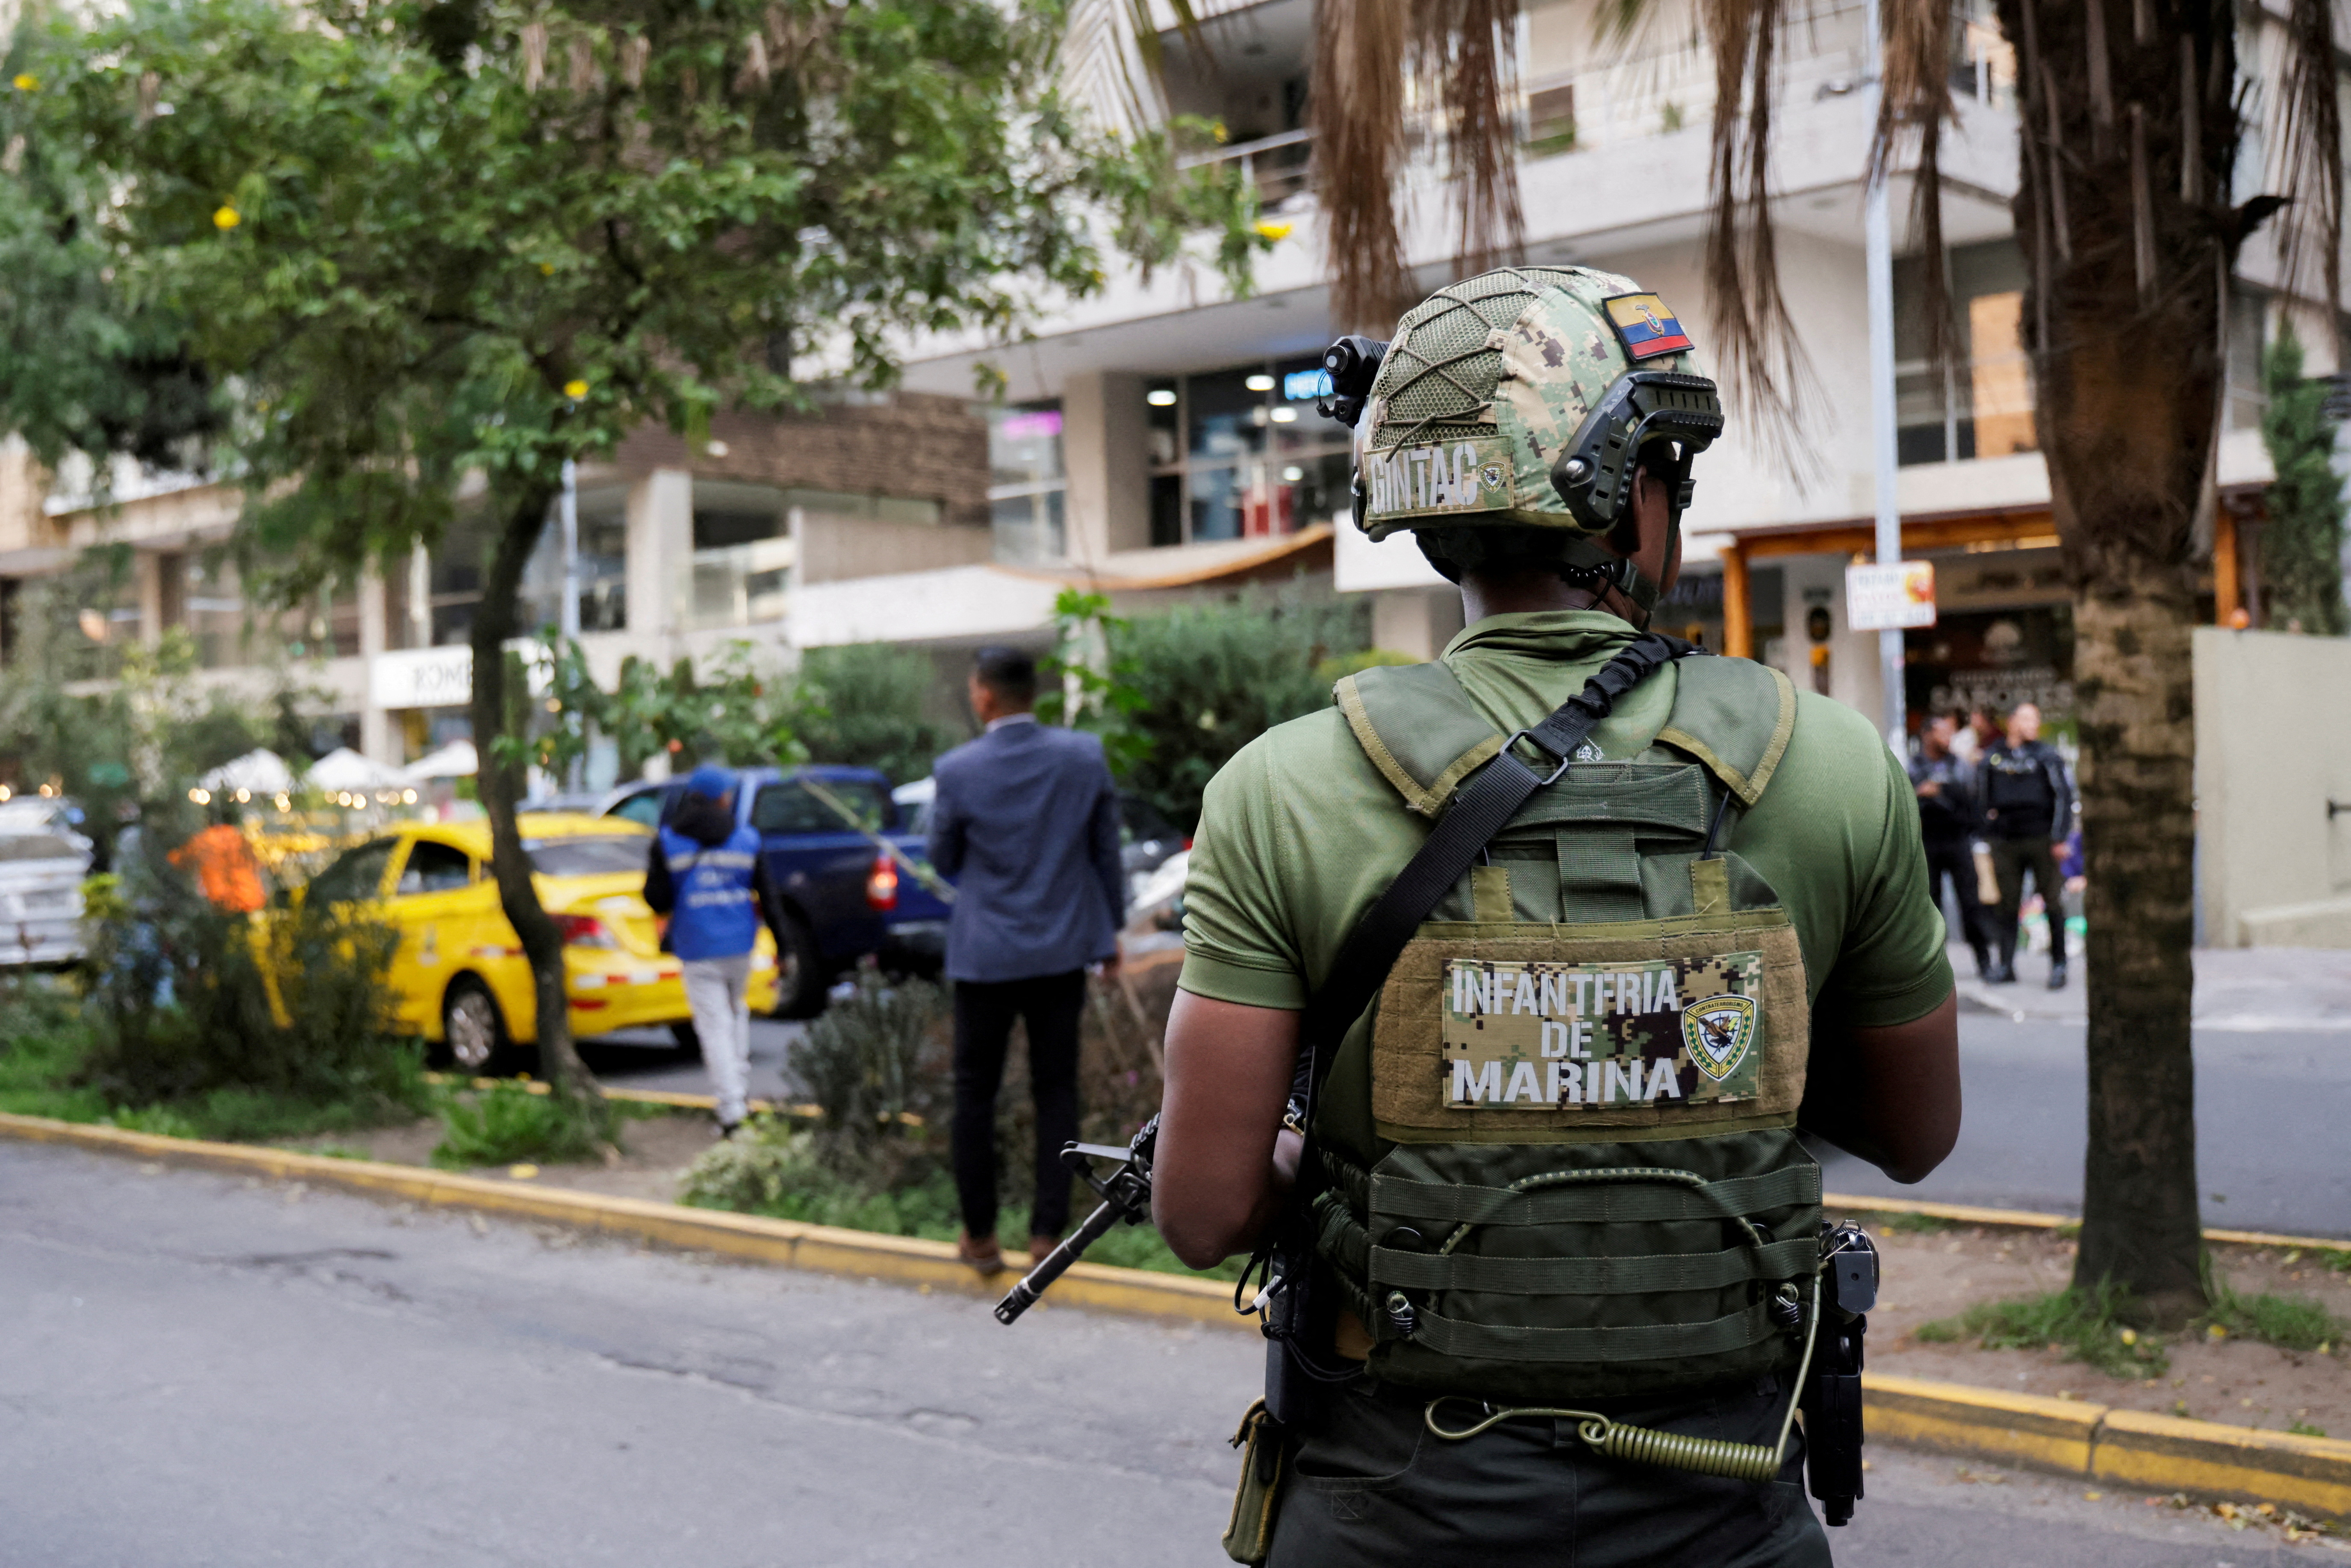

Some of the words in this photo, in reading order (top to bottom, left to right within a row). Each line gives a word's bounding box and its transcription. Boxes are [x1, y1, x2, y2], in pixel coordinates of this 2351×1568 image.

[1371, 444, 1477, 514] GINTAC
[1695, 1001, 1744, 1014] CONTRATERRORISMO
[1541, 1021, 1593, 1058] DE
[1453, 1058, 1681, 1103] MARINA
